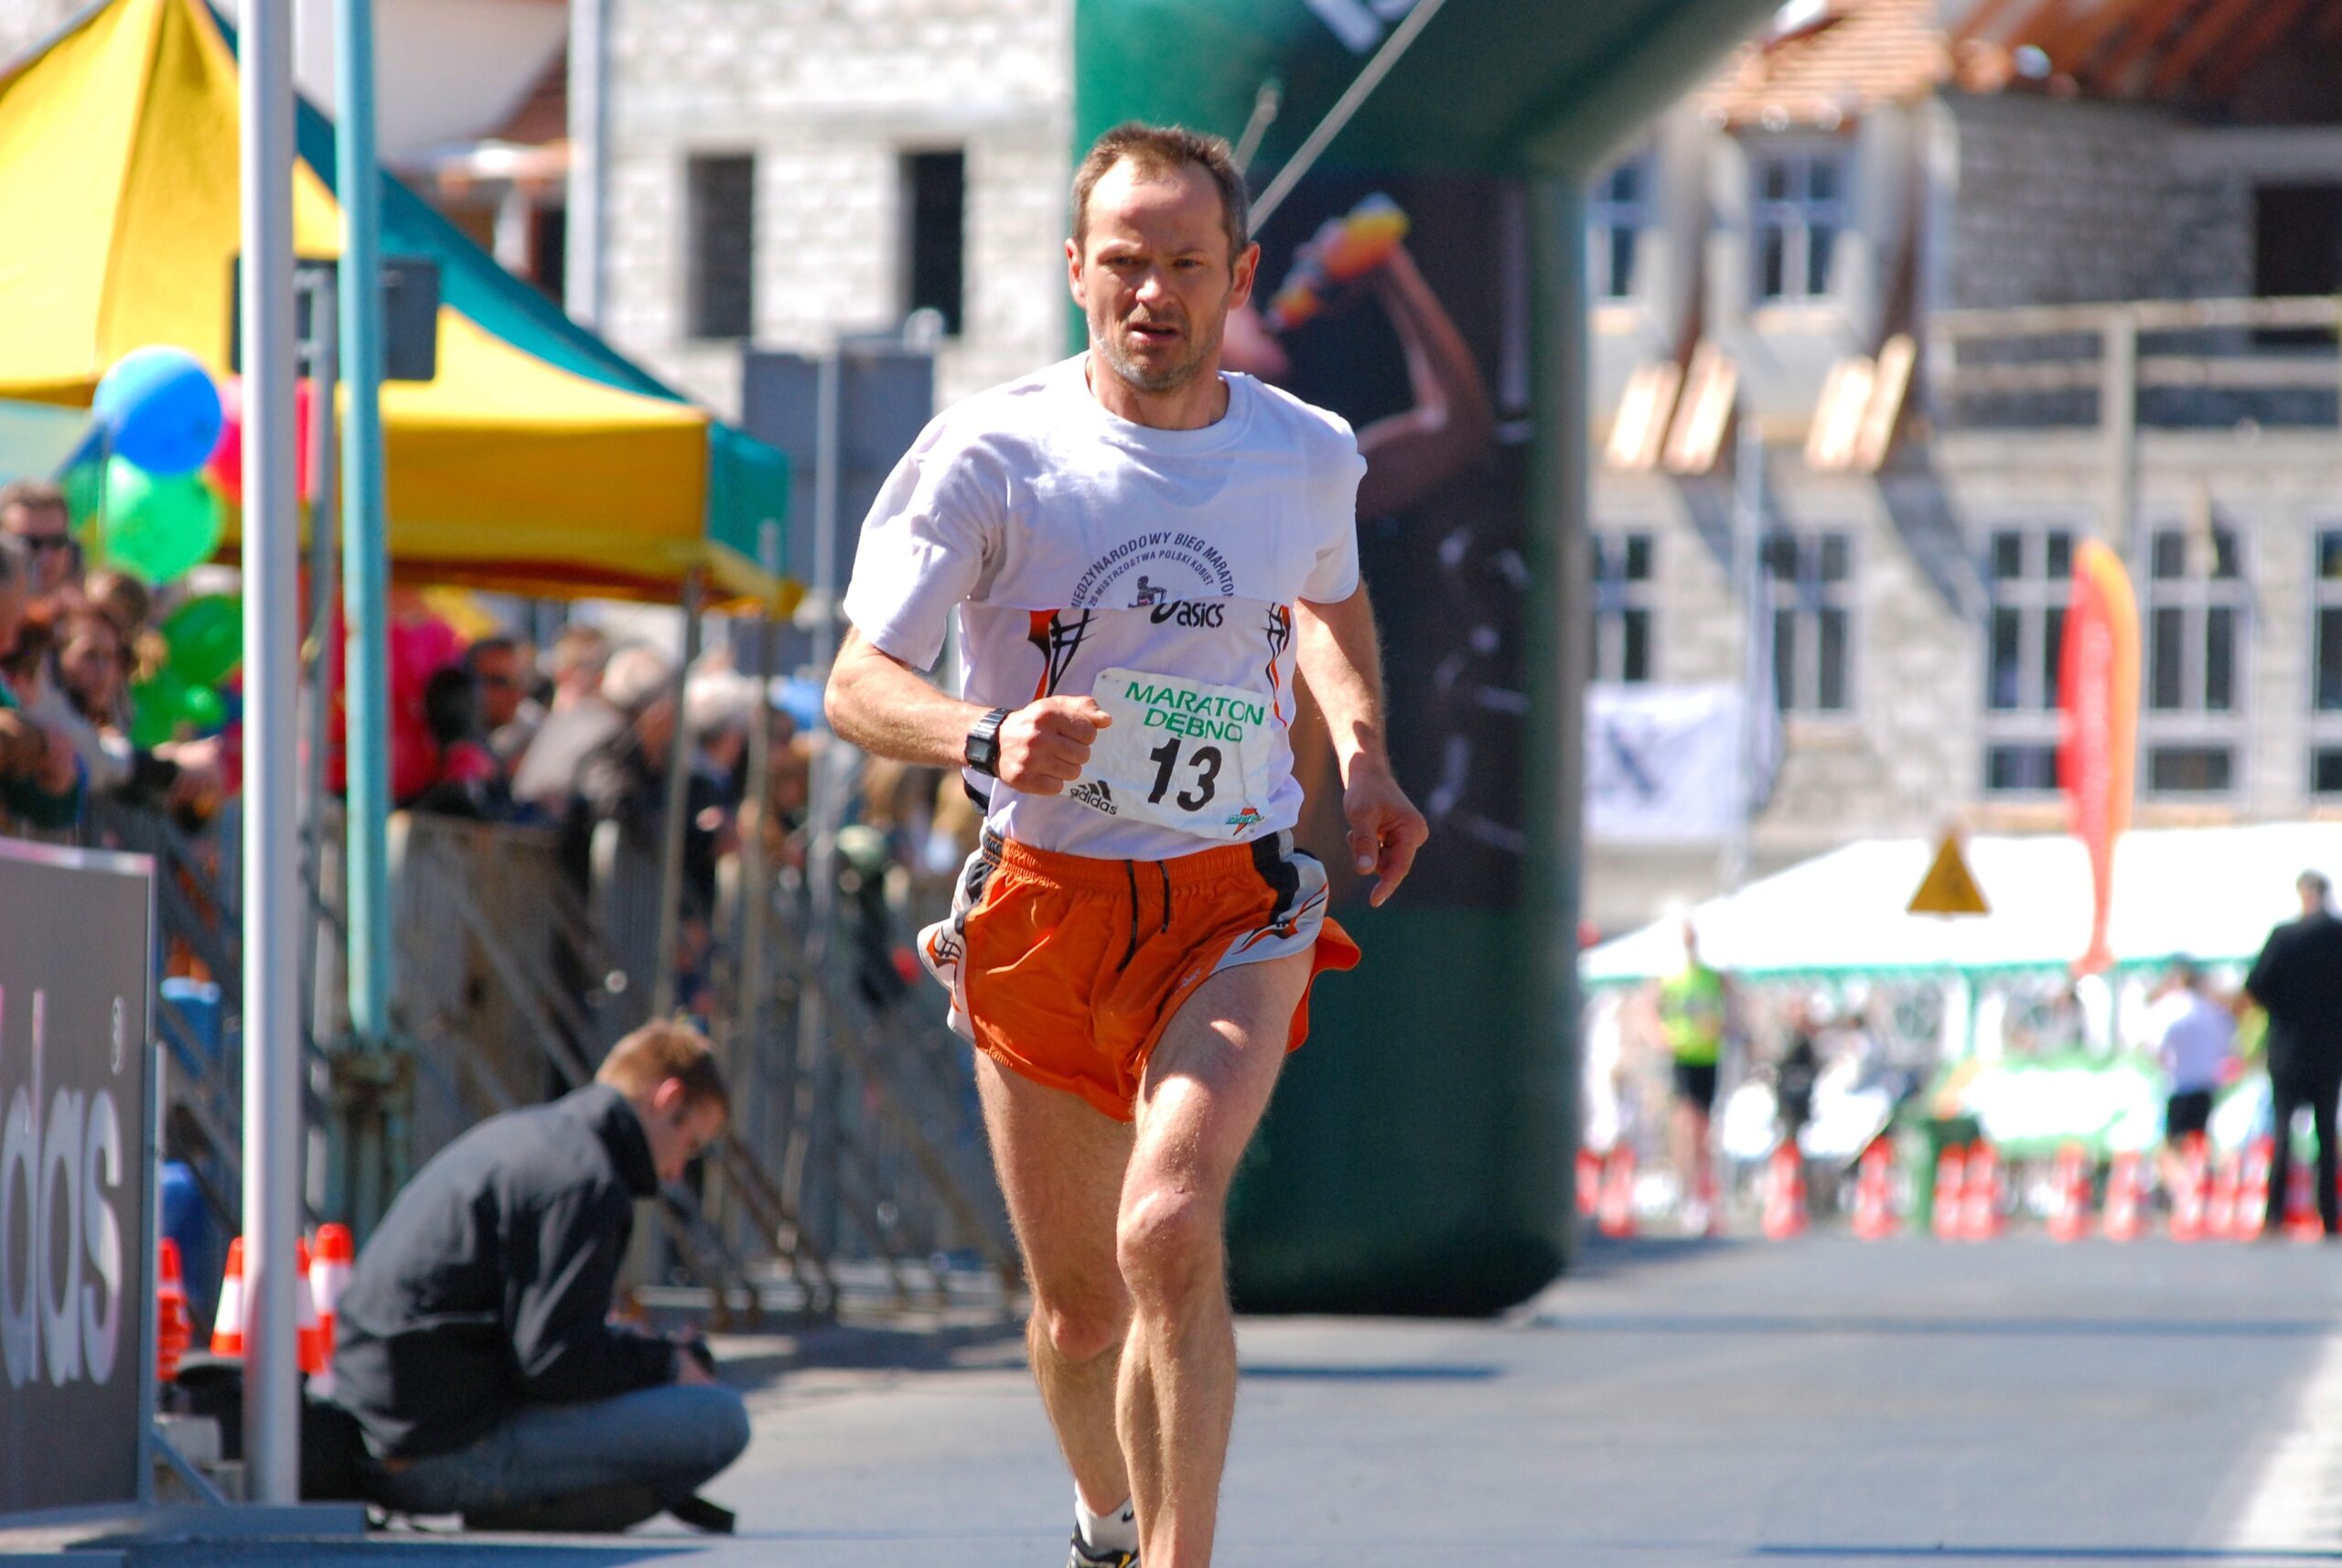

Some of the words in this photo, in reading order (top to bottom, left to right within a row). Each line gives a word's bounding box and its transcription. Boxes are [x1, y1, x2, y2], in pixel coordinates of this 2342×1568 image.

[1174, 532, 1206, 553] BIEG
[1095, 551, 1156, 597] MISTRZOSTWA
[1158, 549, 1192, 564] POLSKI
[1190, 559, 1214, 585] KOBIET
[1124, 681, 1265, 726] MARATON
[1143, 707, 1243, 743] DĘBNO
[1147, 737, 1222, 812] 13
[1070, 788, 1117, 816] adidas
[0, 983, 123, 1389] das
